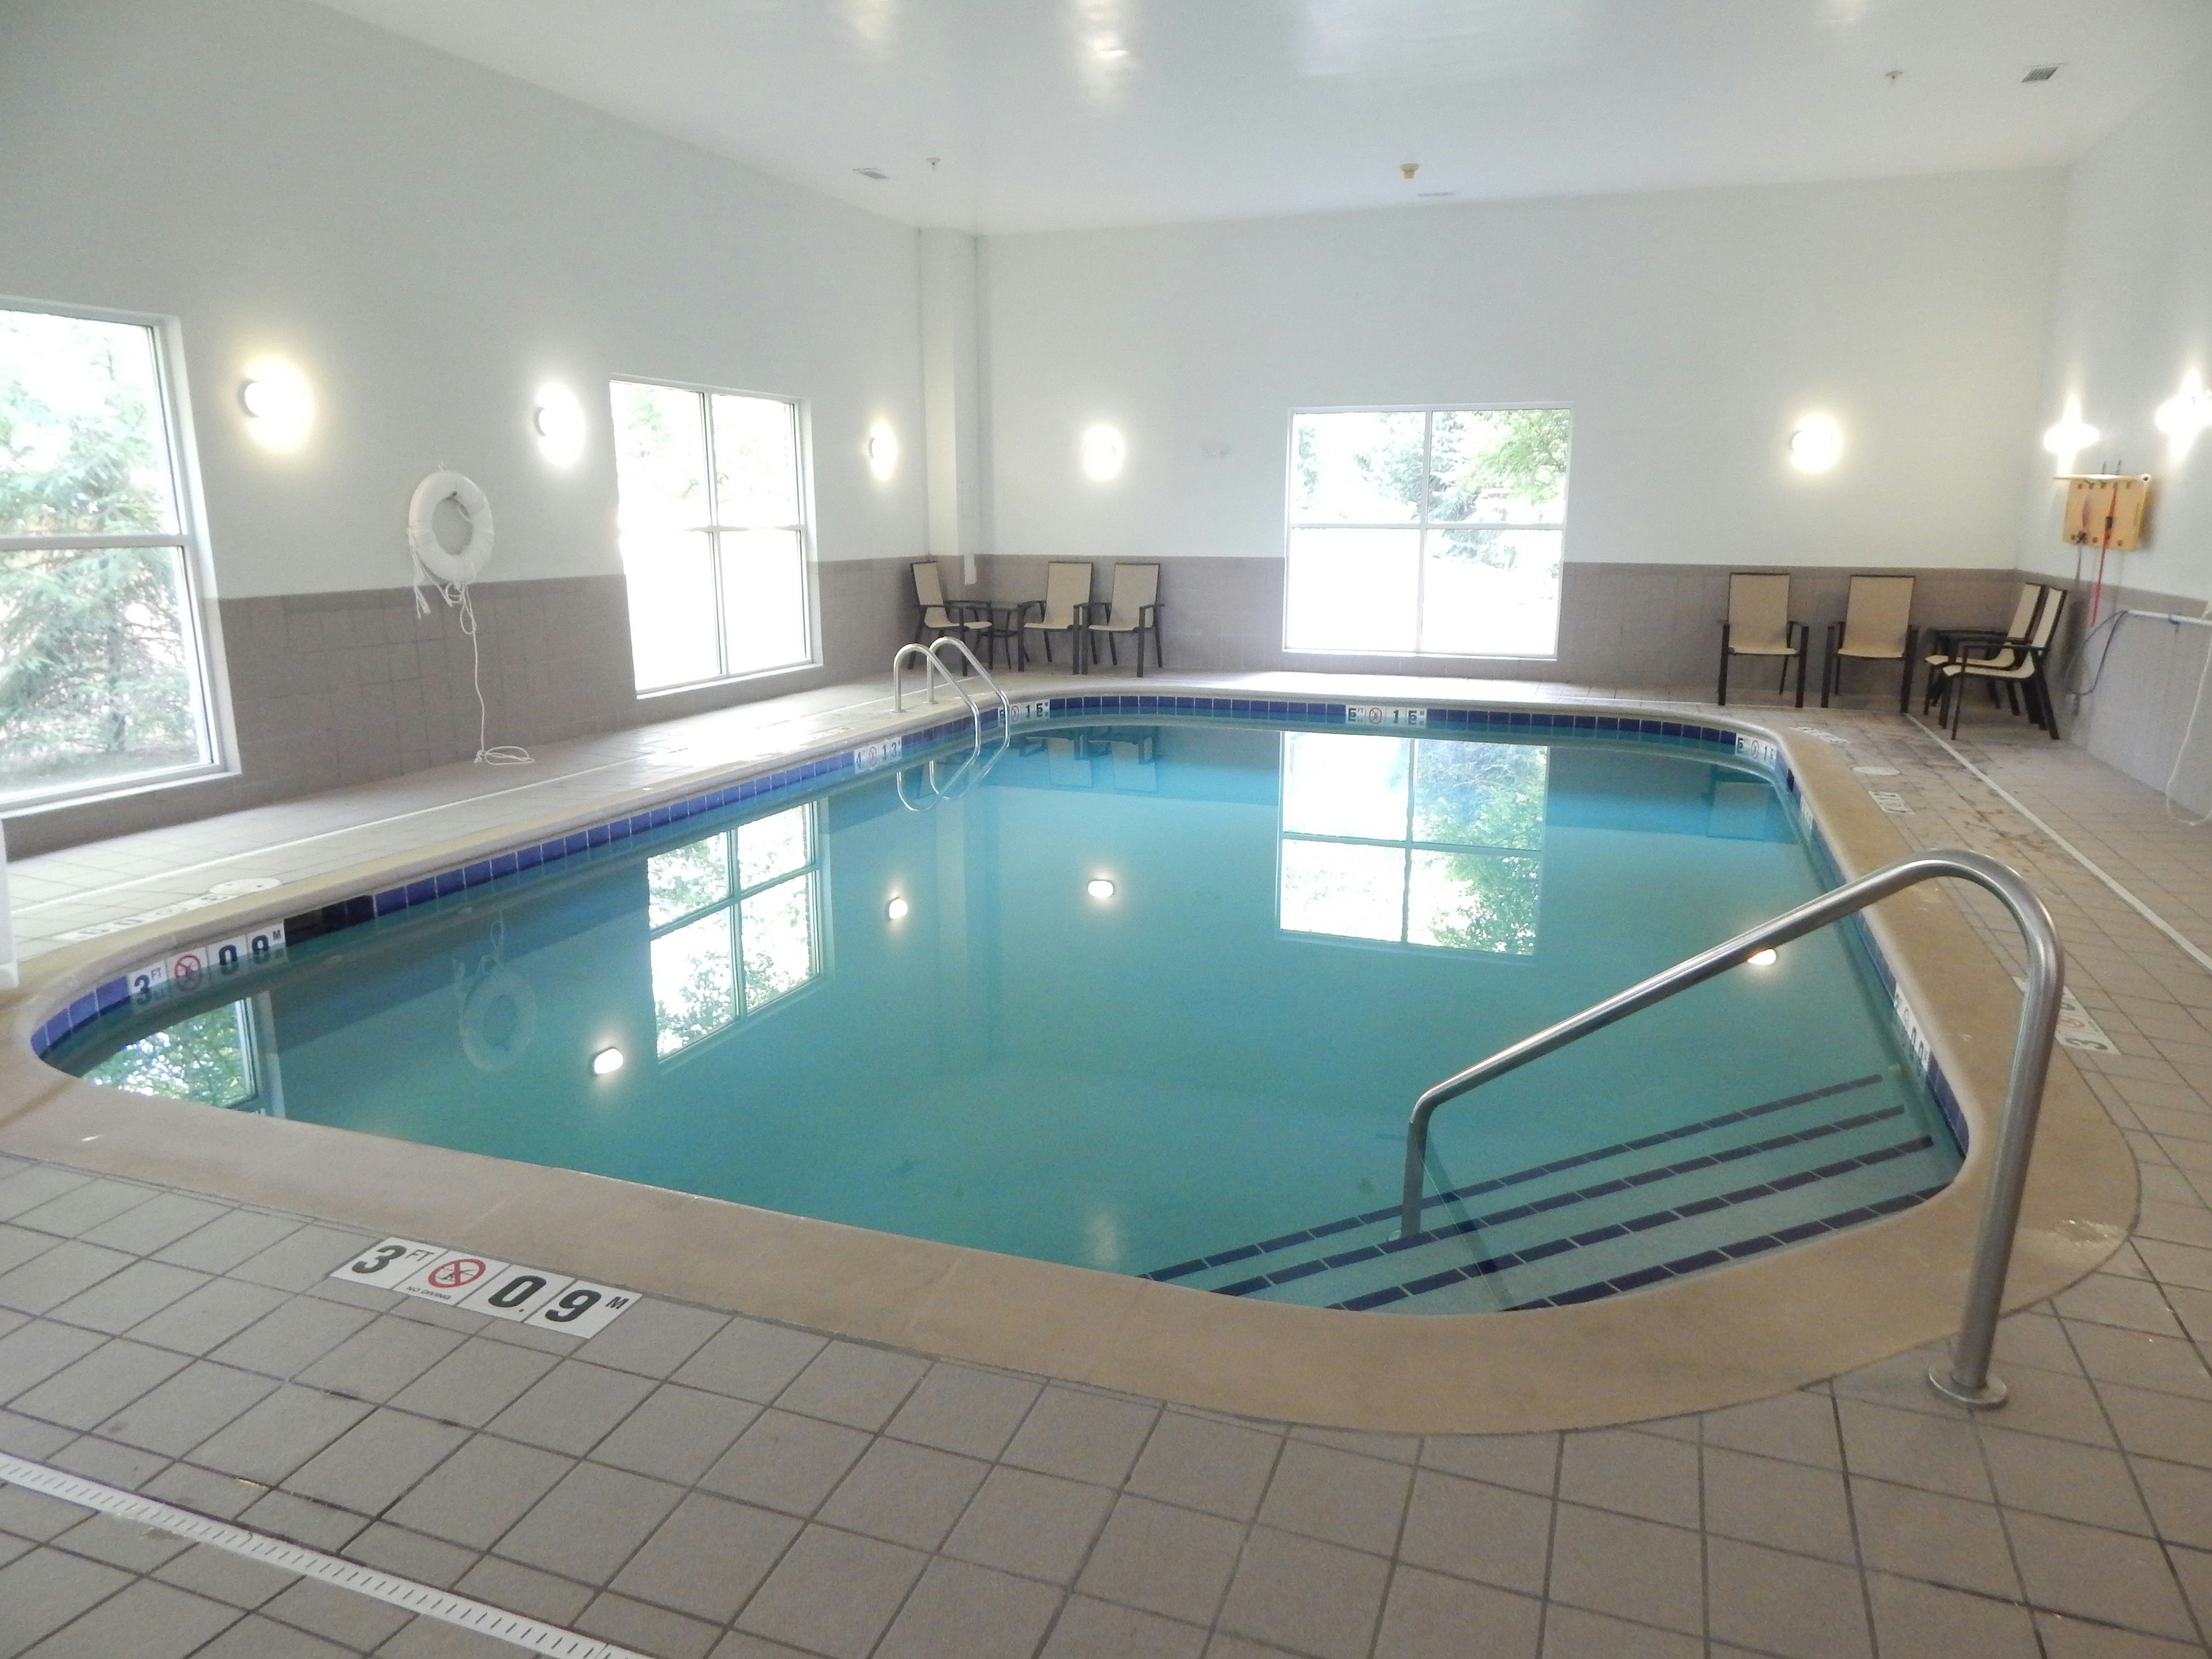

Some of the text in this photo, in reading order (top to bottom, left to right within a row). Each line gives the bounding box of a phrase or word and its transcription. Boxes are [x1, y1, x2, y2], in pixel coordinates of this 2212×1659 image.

[151, 967, 162, 980] FT
[273, 929, 281, 940] M
[351, 1245, 407, 1274] 3
[405, 1249, 435, 1262] FT
[605, 1296, 630, 1310] M
